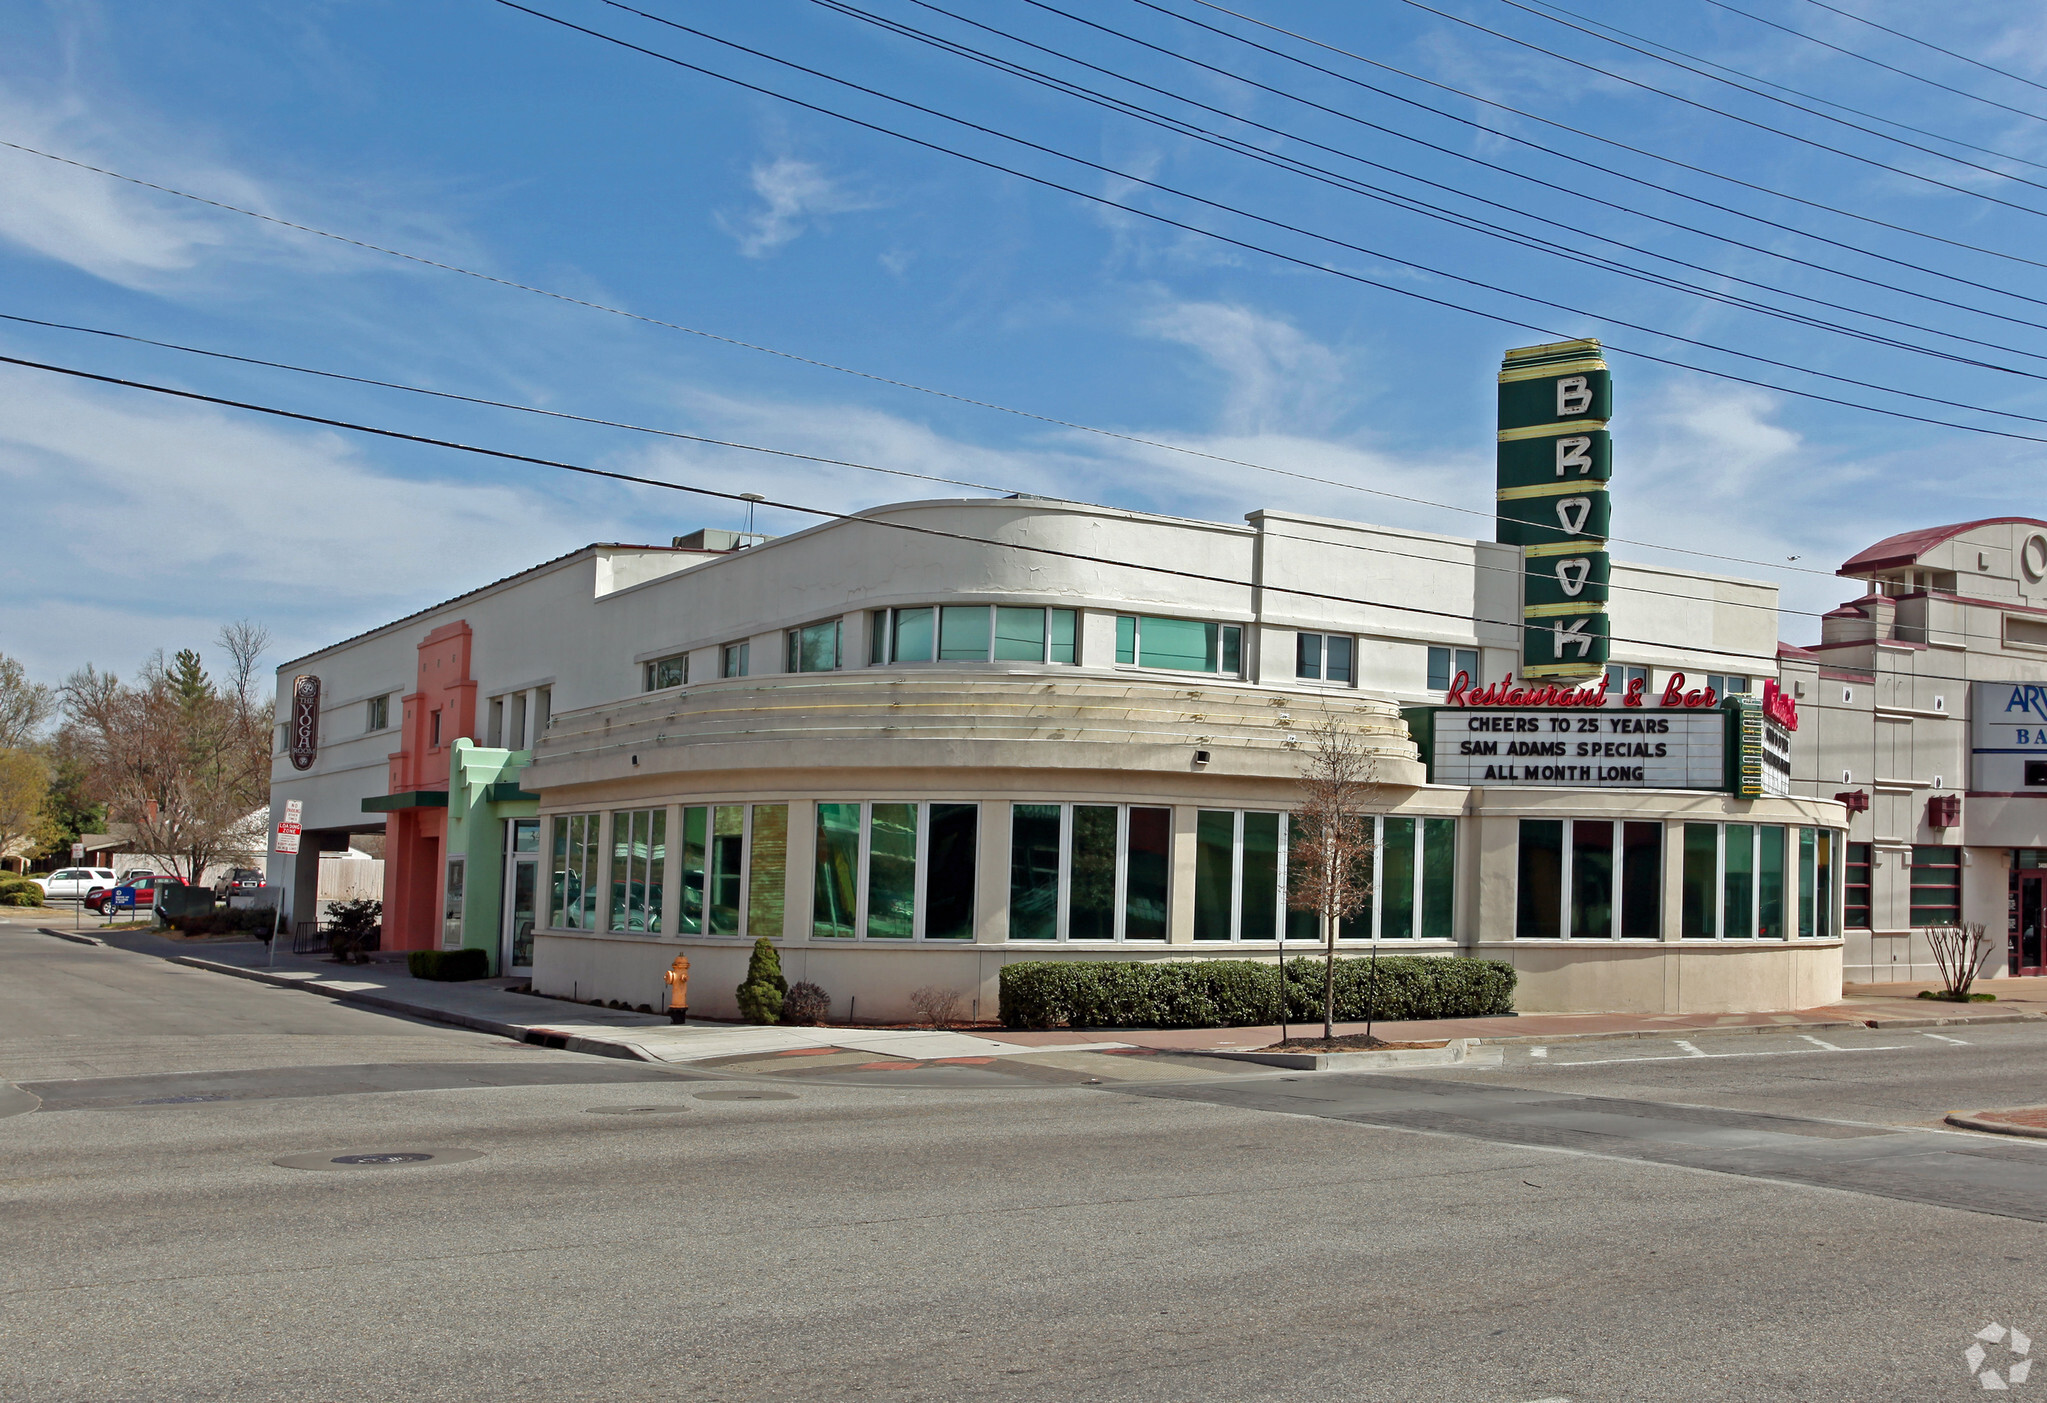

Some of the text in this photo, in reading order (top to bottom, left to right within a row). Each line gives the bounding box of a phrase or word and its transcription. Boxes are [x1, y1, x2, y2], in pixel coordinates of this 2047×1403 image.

[1554, 375, 1593, 659] BROOK
[1447, 669, 1718, 708] Restaurant & Bar
[298, 704, 313, 748] YOGA
[1468, 716, 1670, 734] CHEERS TO 25 YEARS
[1460, 740, 1668, 758] SAM ADAMS SPECIALS
[1484, 764, 1643, 781] ALL MONTH LONG
